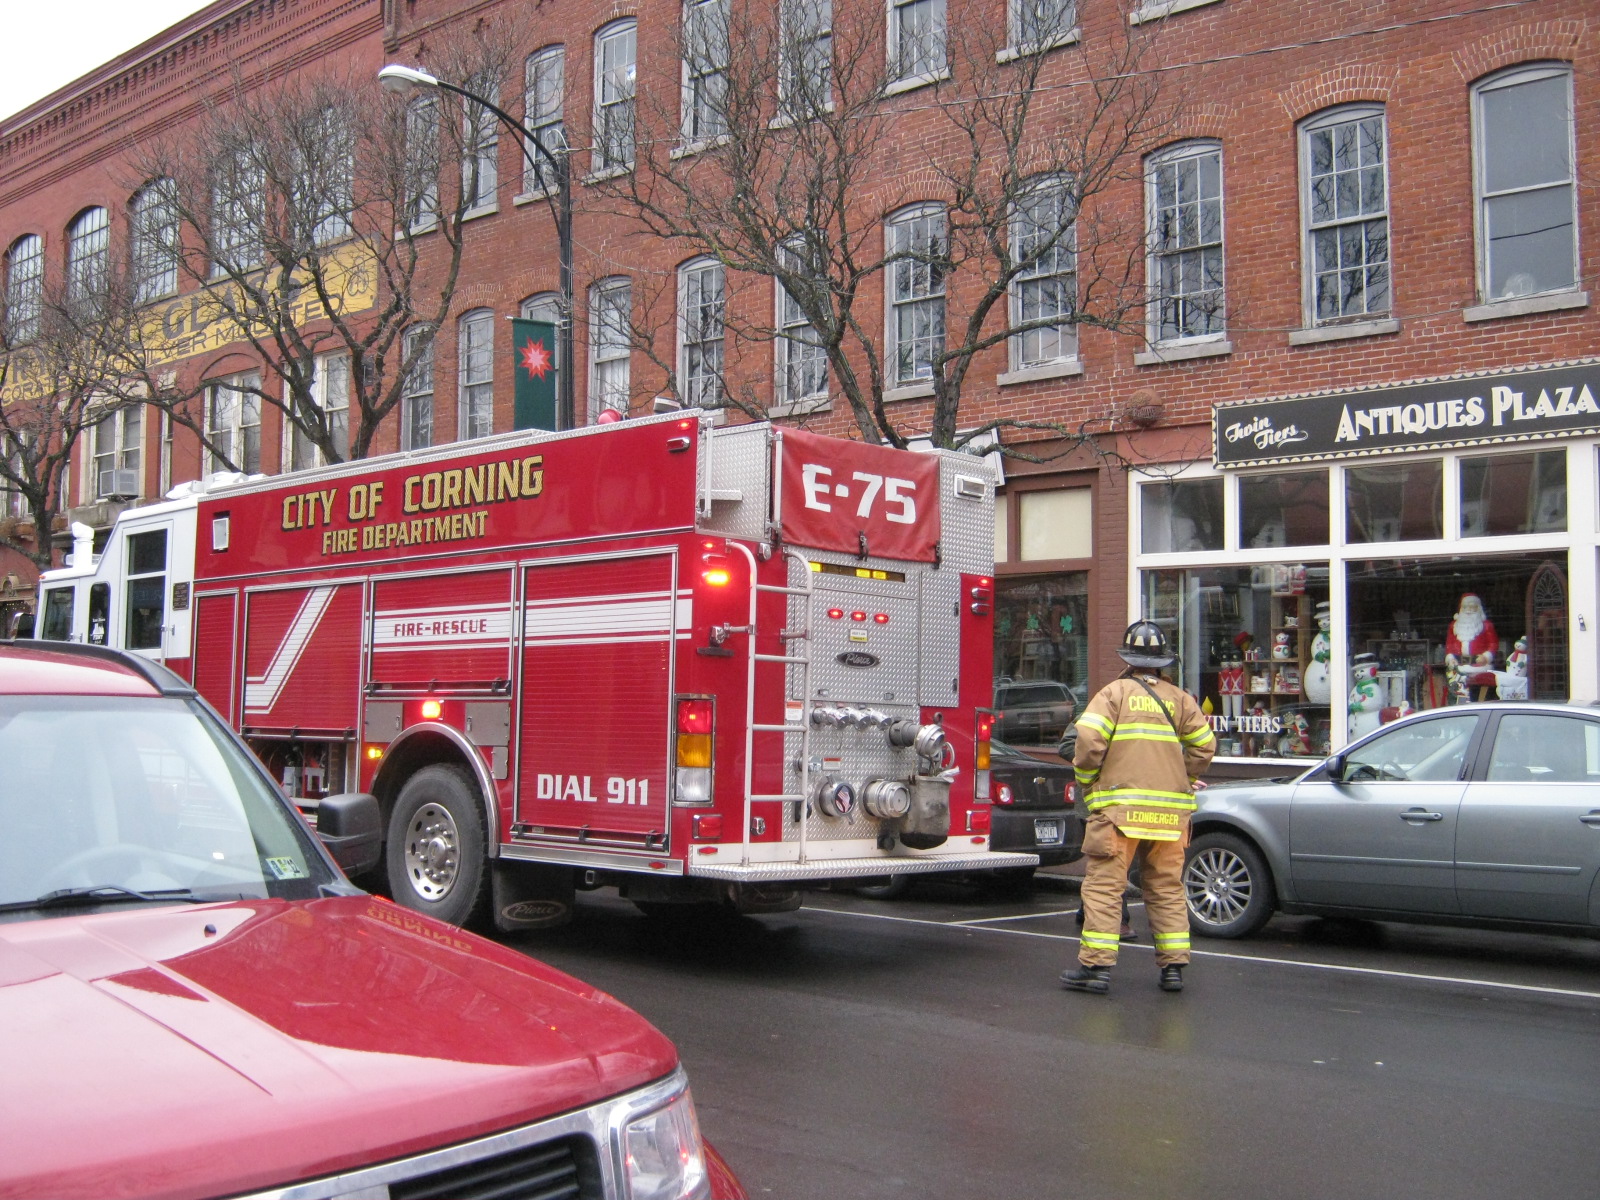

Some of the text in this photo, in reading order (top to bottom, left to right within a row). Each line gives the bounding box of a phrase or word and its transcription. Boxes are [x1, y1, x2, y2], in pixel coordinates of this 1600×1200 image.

[215, 292, 343, 346] MOUTED
[1334, 383, 1600, 442] ANTIQUES PLAZA
[1225, 416, 1271, 443] Twin
[1254, 424, 1308, 449] Tiers
[281, 455, 544, 532] CITY OF CORNING
[802, 463, 916, 524] E-75
[321, 510, 489, 556] FIRE DEPARTMENT
[394, 618, 487, 637] FIRE-RESCUE
[1235, 715, 1281, 734] TIERS
[537, 773, 648, 806] DIAL 911
[1126, 810, 1179, 826] LEONBERGER
[513, 903, 555, 917] Pierce
